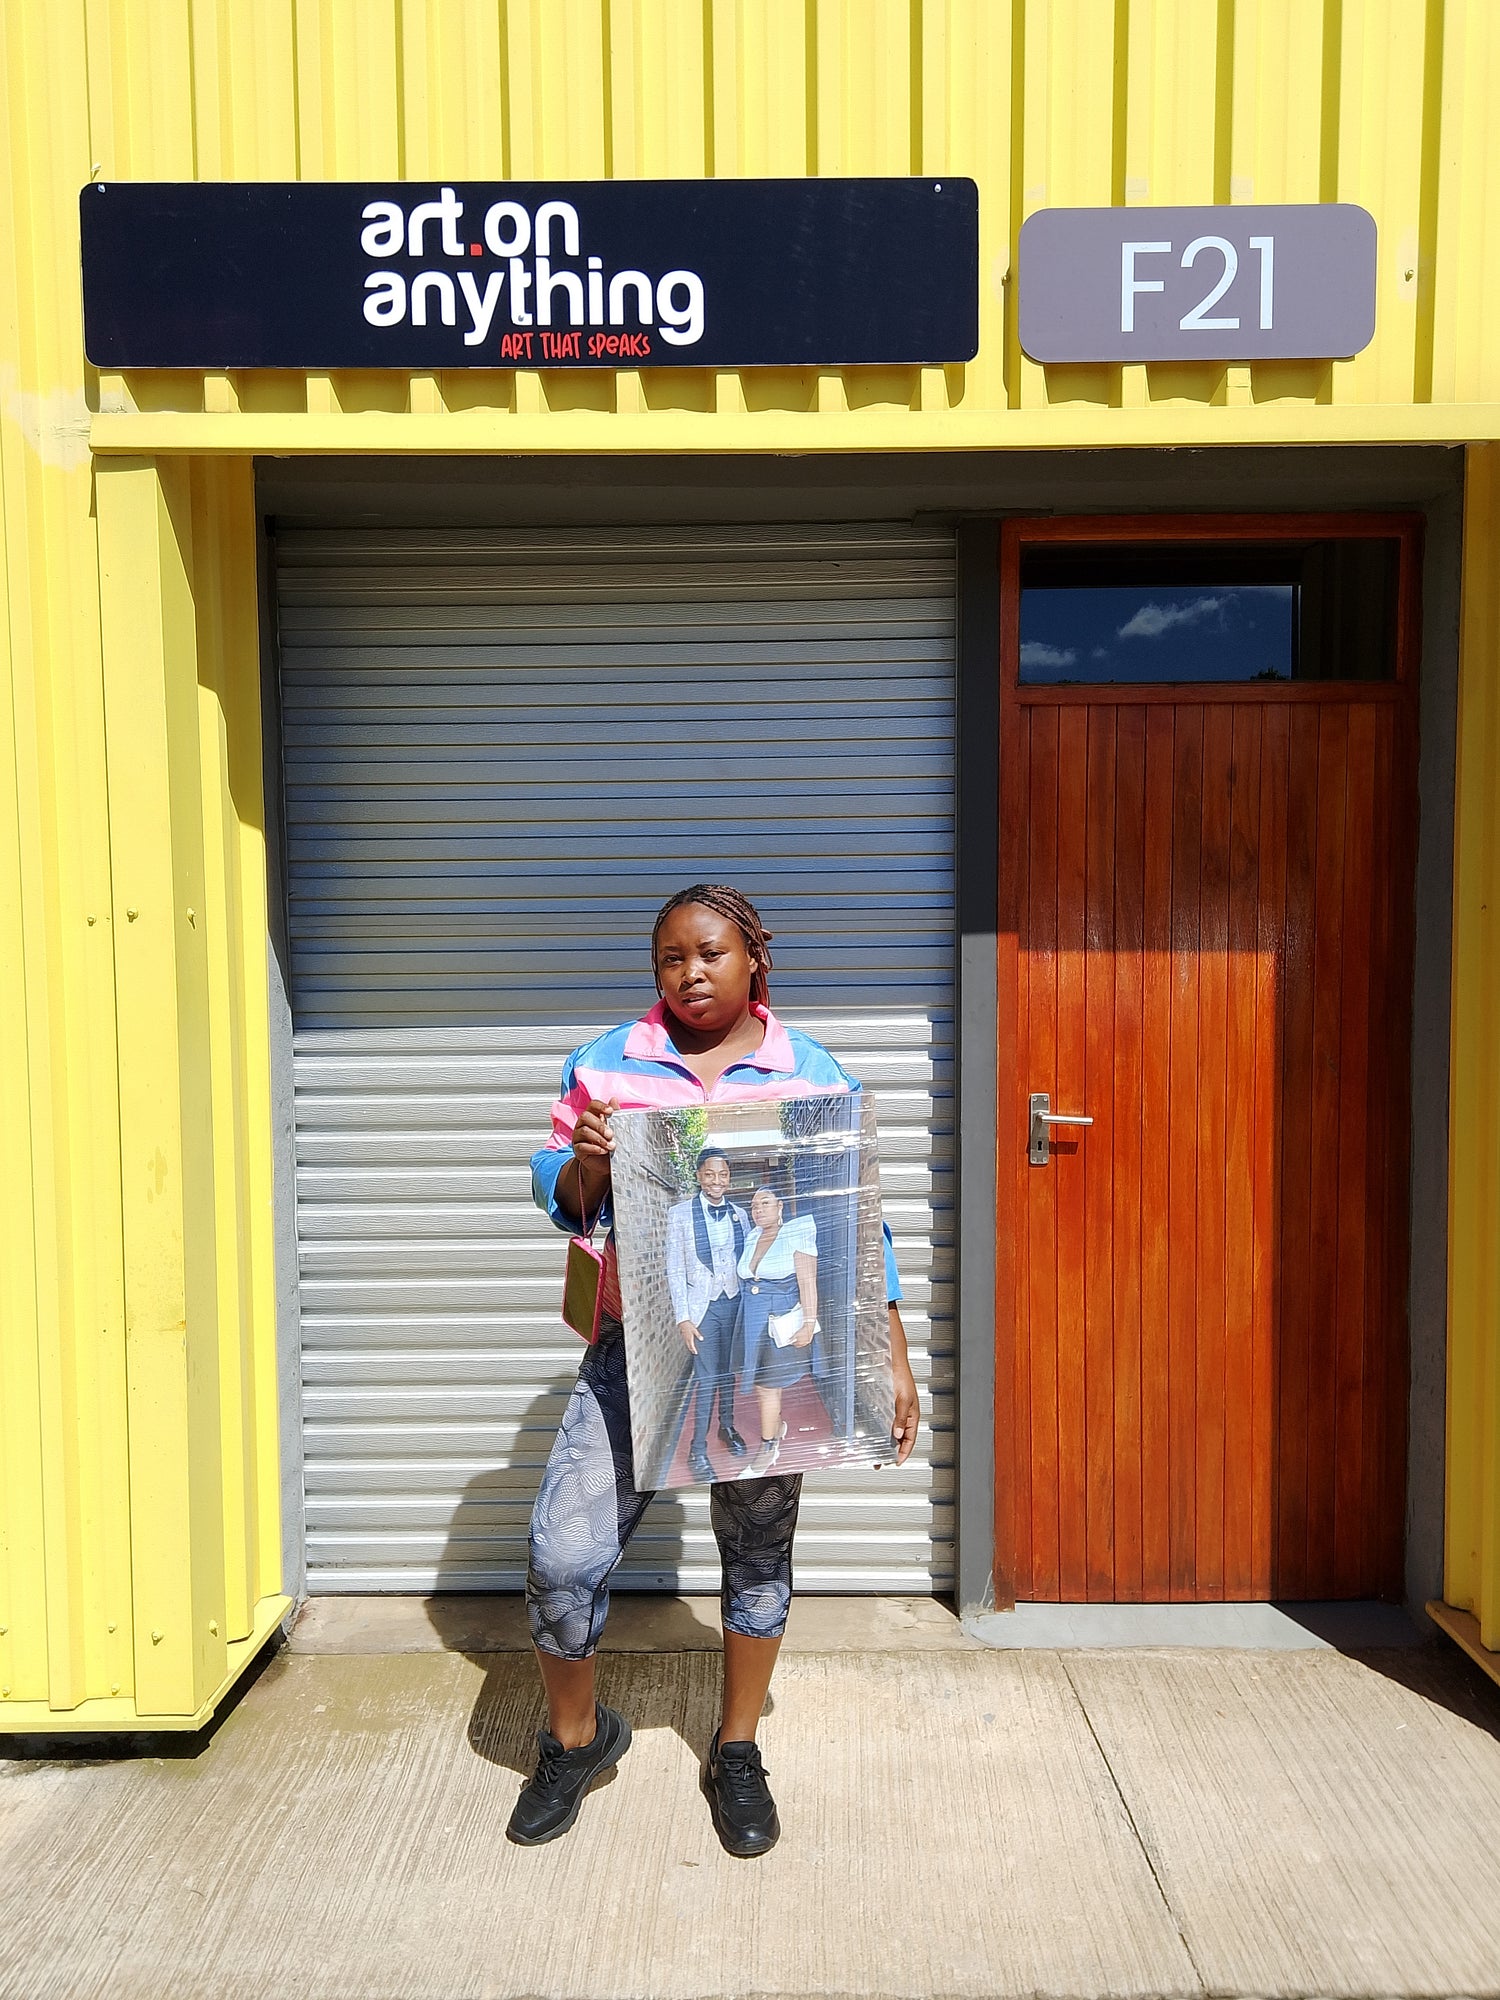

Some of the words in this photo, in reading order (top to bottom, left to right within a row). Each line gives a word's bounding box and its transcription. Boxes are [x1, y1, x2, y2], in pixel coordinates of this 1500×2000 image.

[362, 256, 705, 346] anything
[1121, 236, 1274, 332] F21
[501, 332, 534, 360] ART
[539, 332, 582, 360] THAT
